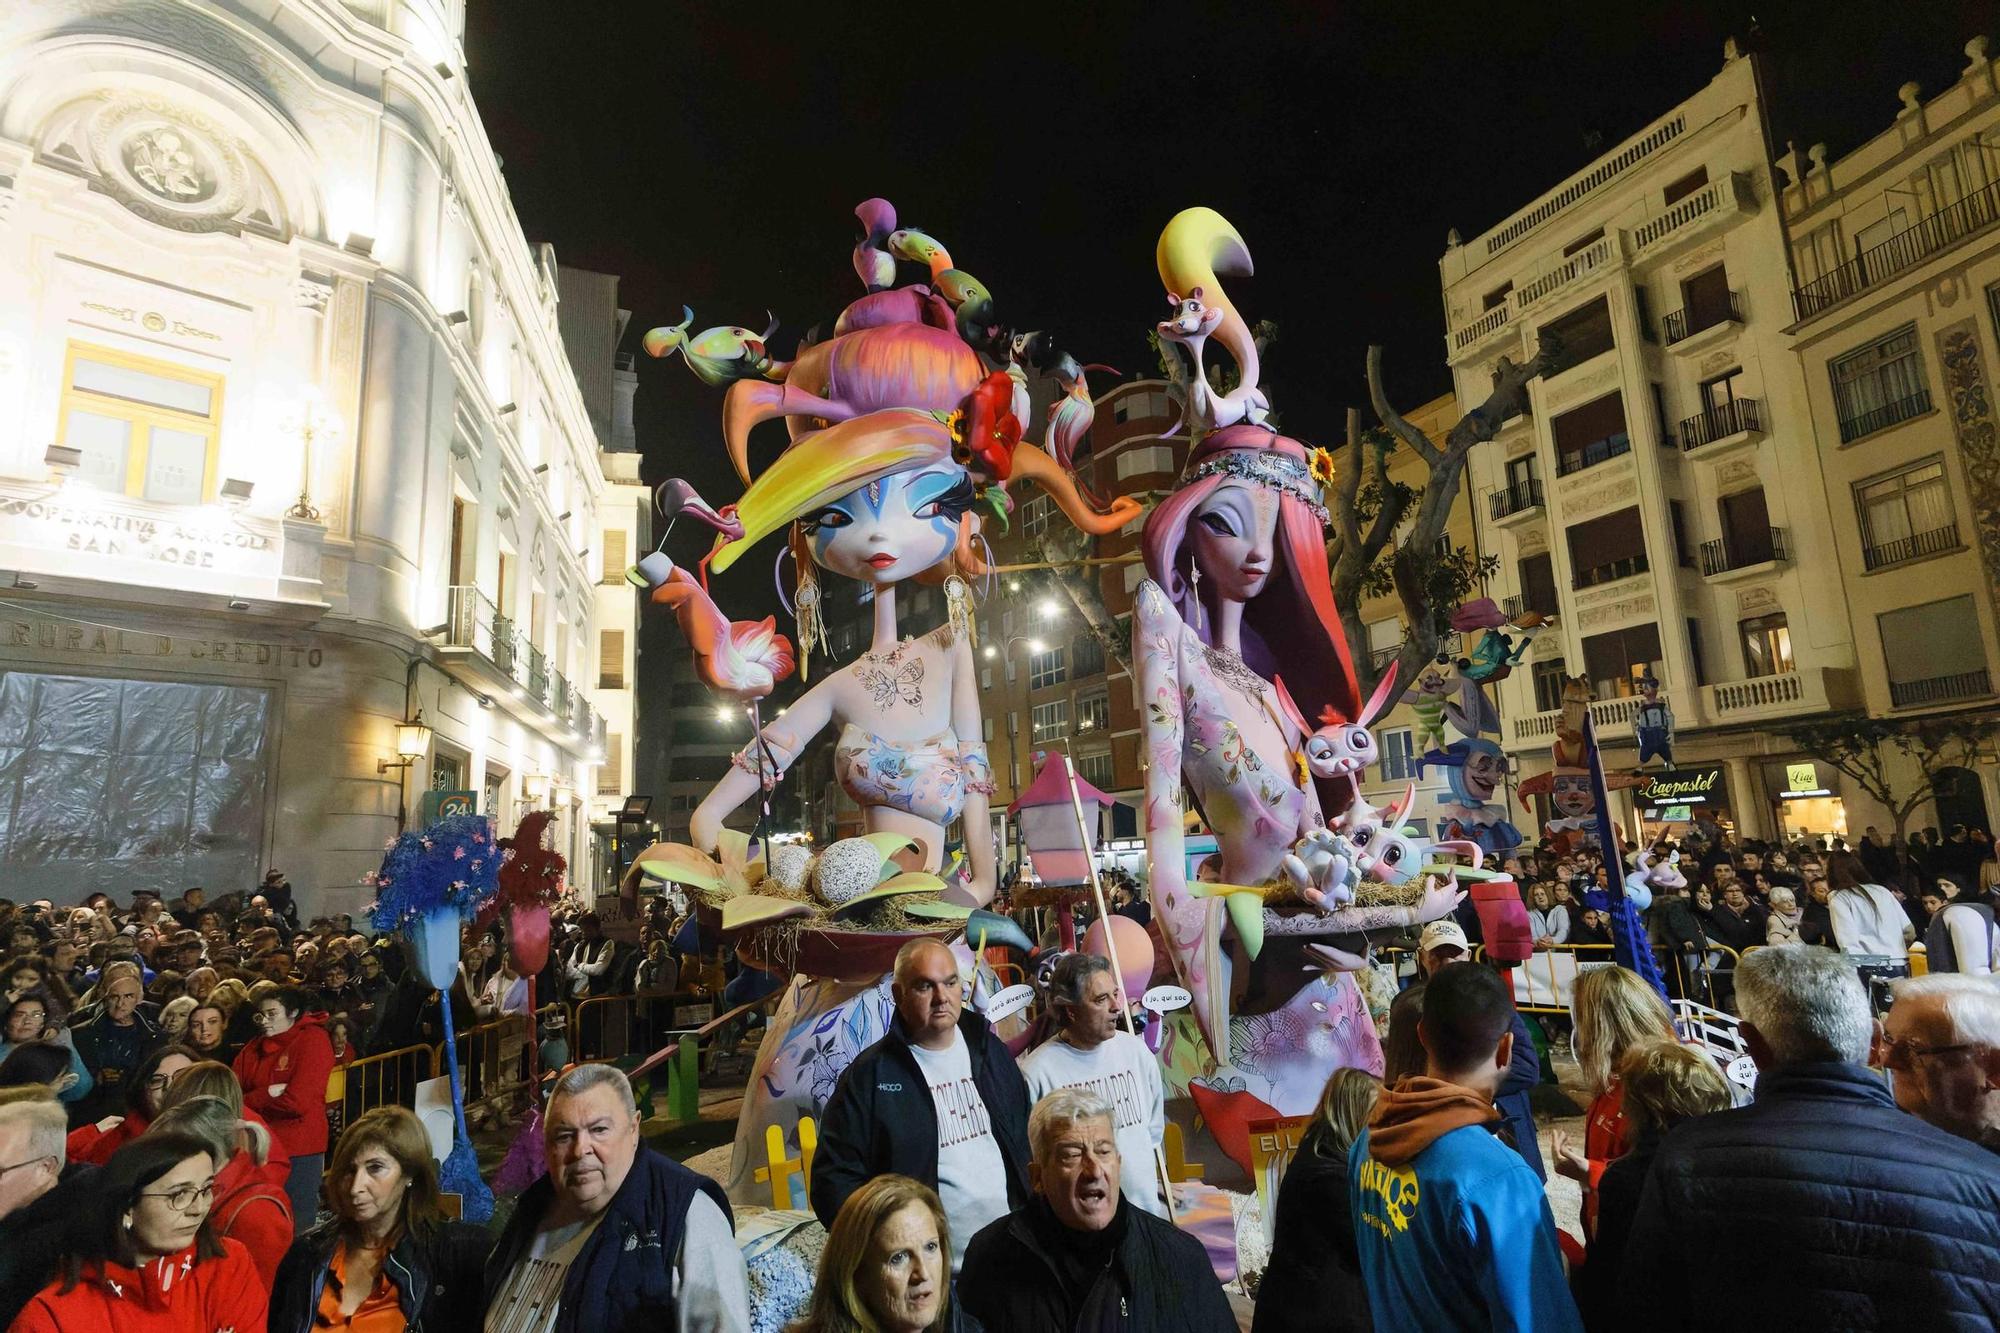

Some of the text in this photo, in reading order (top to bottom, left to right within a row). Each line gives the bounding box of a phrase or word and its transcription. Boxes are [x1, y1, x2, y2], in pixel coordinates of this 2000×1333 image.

[66, 532, 123, 554] SAN
[10, 622, 133, 655] RURAL
[191, 640, 323, 668] CREDITO
